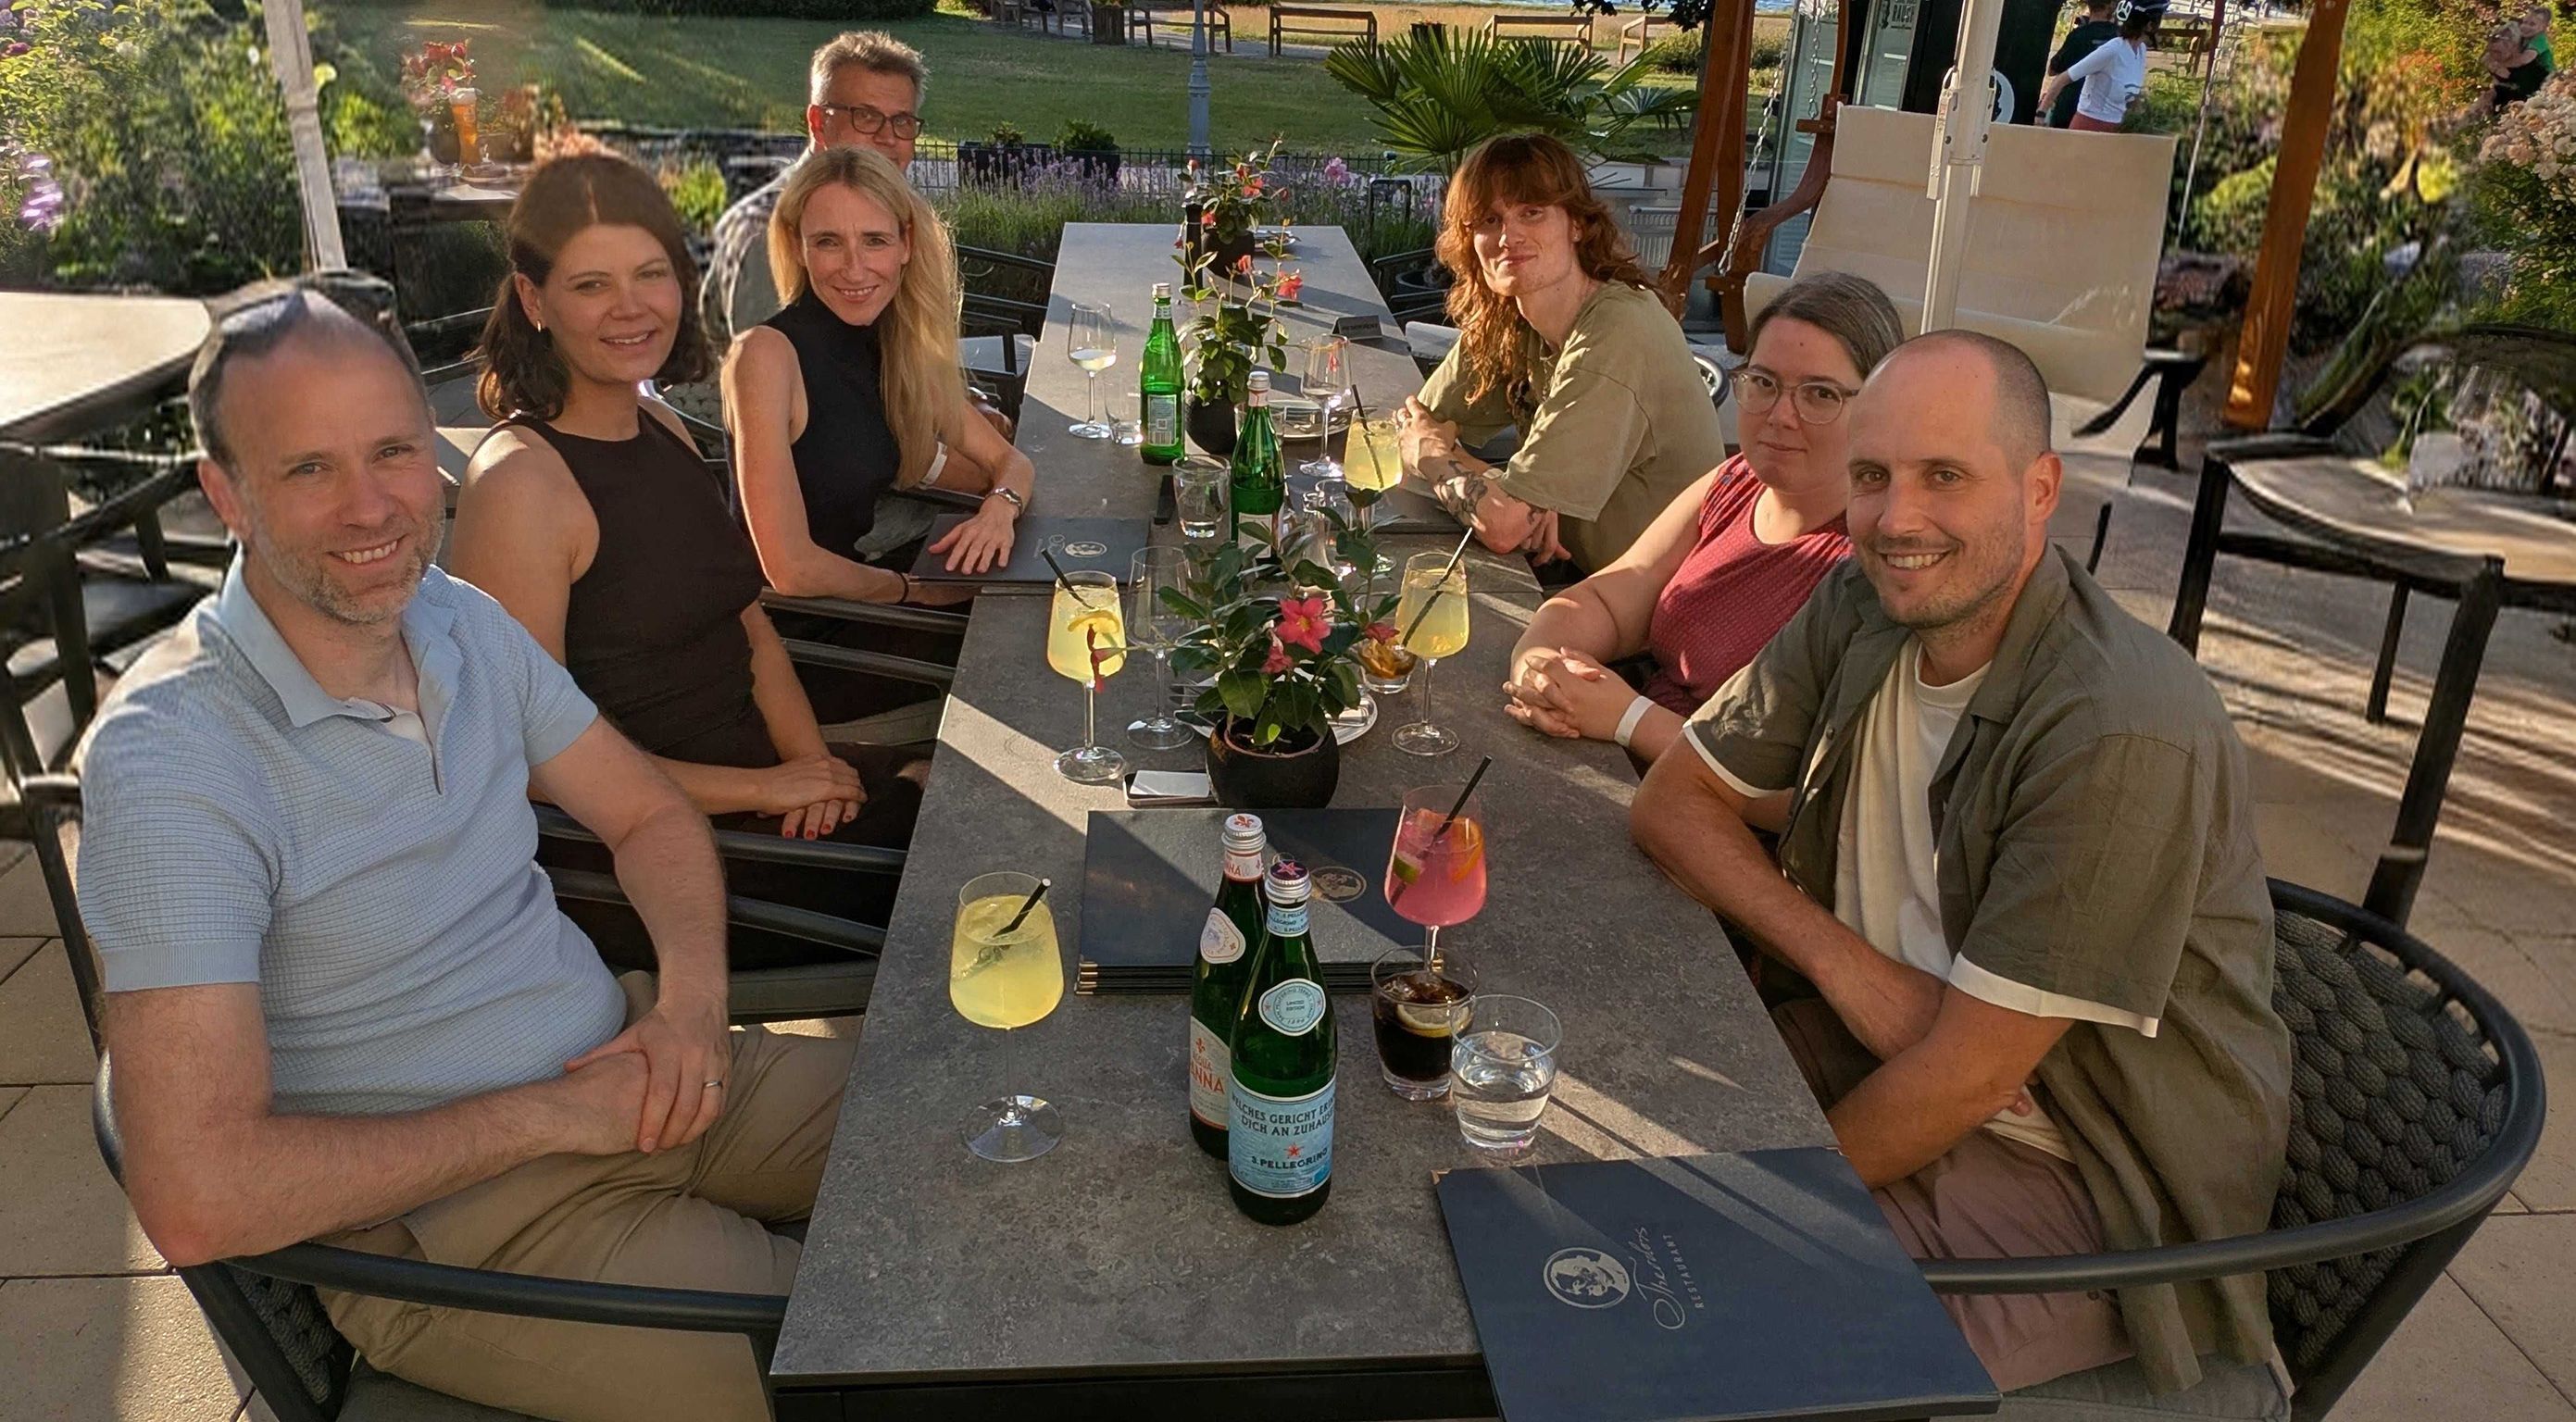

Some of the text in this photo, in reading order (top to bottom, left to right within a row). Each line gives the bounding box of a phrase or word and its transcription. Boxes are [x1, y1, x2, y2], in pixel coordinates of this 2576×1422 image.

[1242, 1115, 1268, 1135] DICH
[1271, 1126, 1289, 1137] AN
[1269, 1108, 1317, 1125] GERICHT
[1662, 1234, 1705, 1308] RESTAURANT
